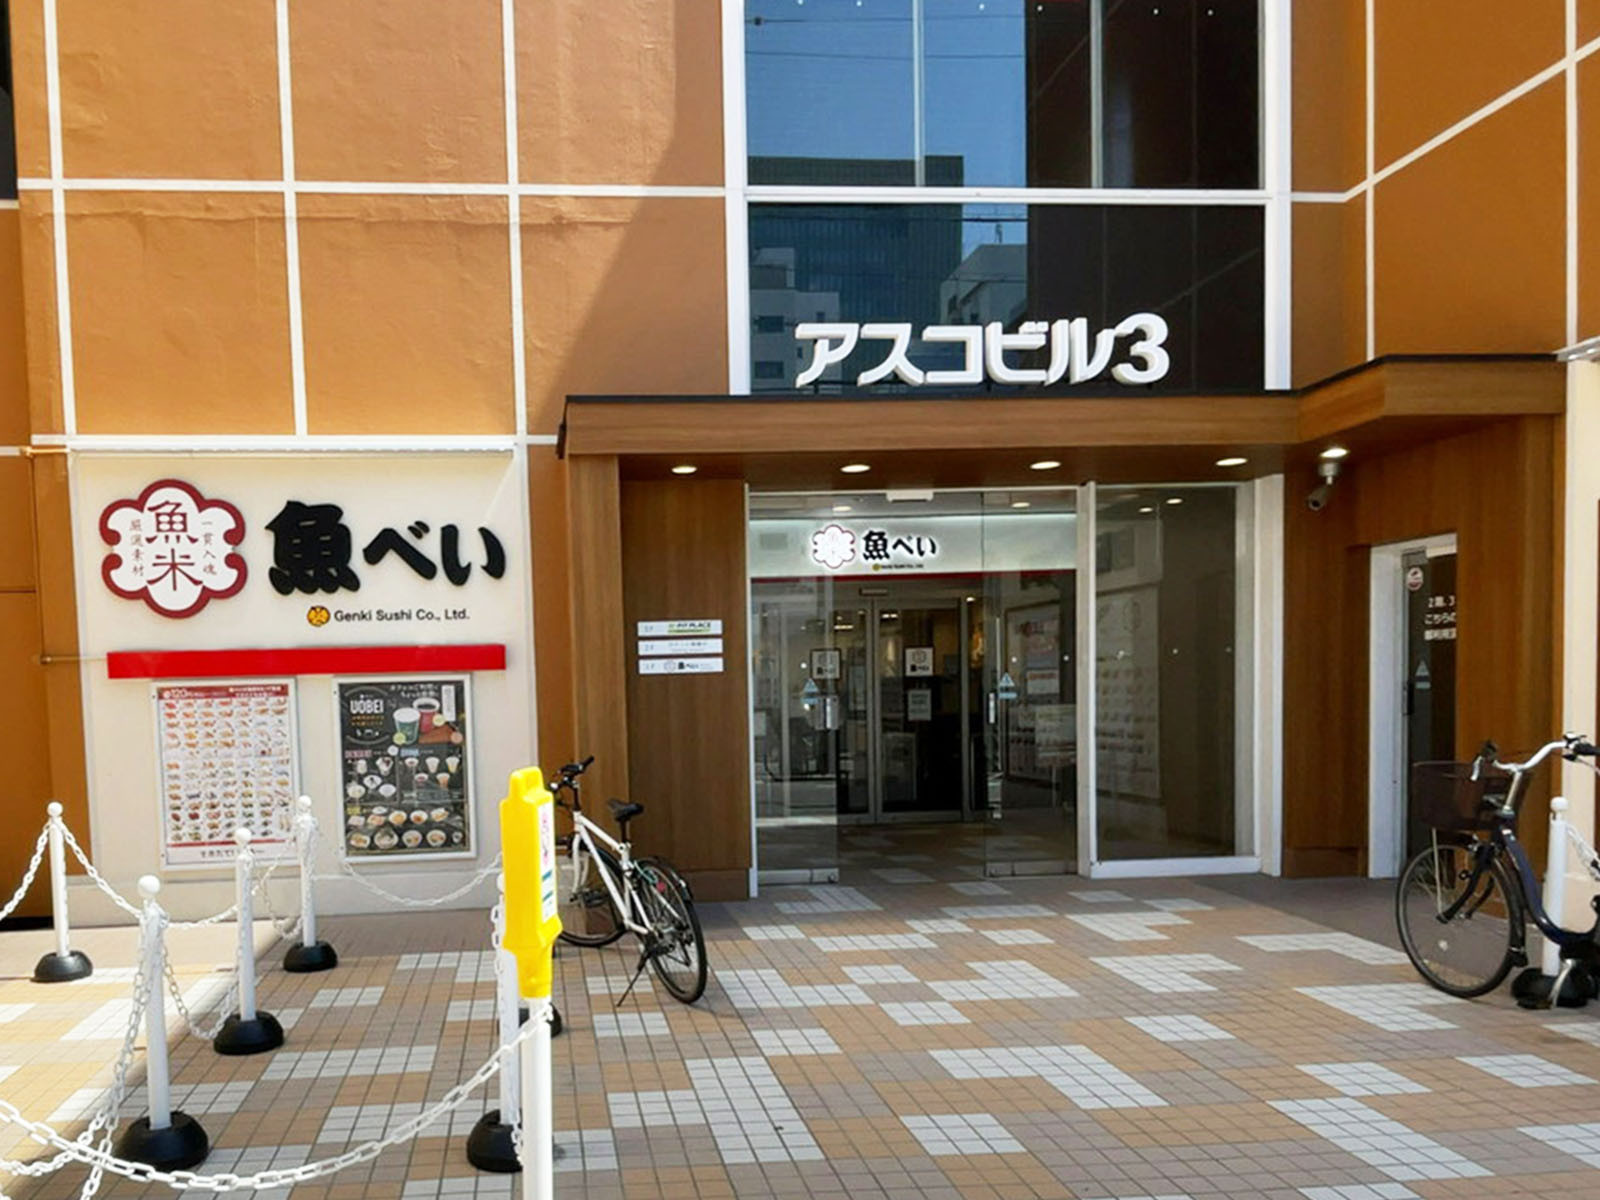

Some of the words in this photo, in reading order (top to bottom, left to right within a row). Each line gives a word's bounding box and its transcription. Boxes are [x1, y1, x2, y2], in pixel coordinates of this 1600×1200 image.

[795, 312, 1170, 387] アスコビル3
[264, 501, 506, 596] 魚べい
[334, 609, 372, 622] Genki
[376, 609, 412, 621] Sushi
[444, 608, 470, 620] Ltd.
